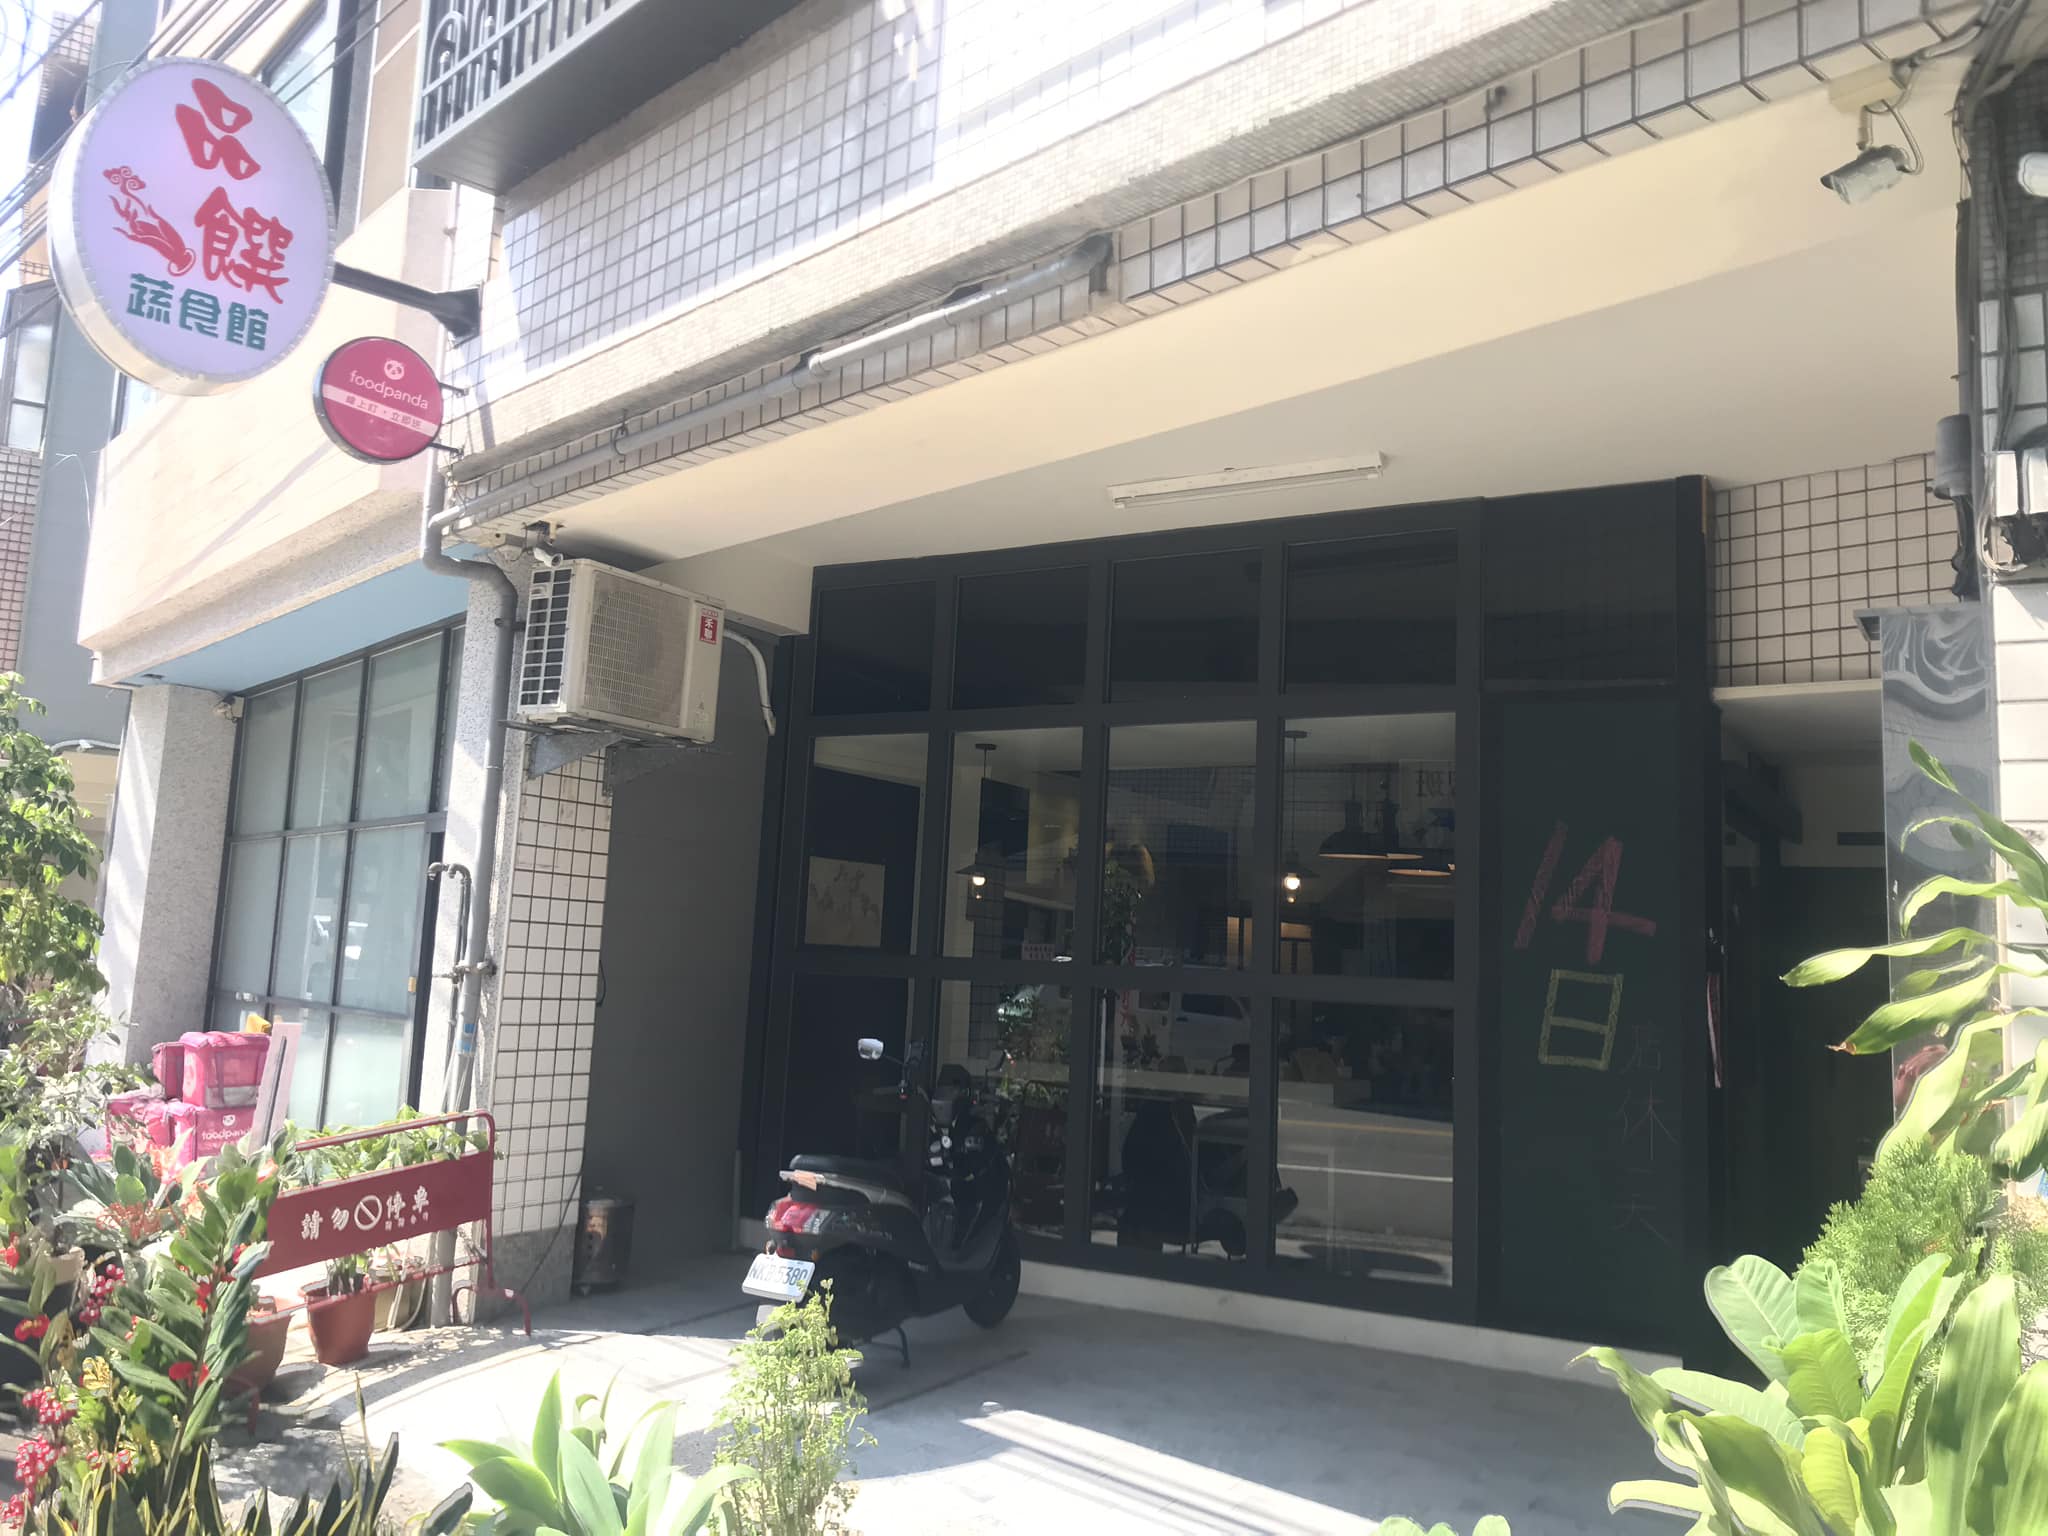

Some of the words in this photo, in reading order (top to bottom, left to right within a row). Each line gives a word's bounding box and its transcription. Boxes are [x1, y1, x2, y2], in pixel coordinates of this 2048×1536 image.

[126, 272, 270, 352] 蔬食館
[350, 369, 428, 409] foodpanda
[1513, 818, 1658, 965] 14
[301, 1207, 350, 1240] 請勿
